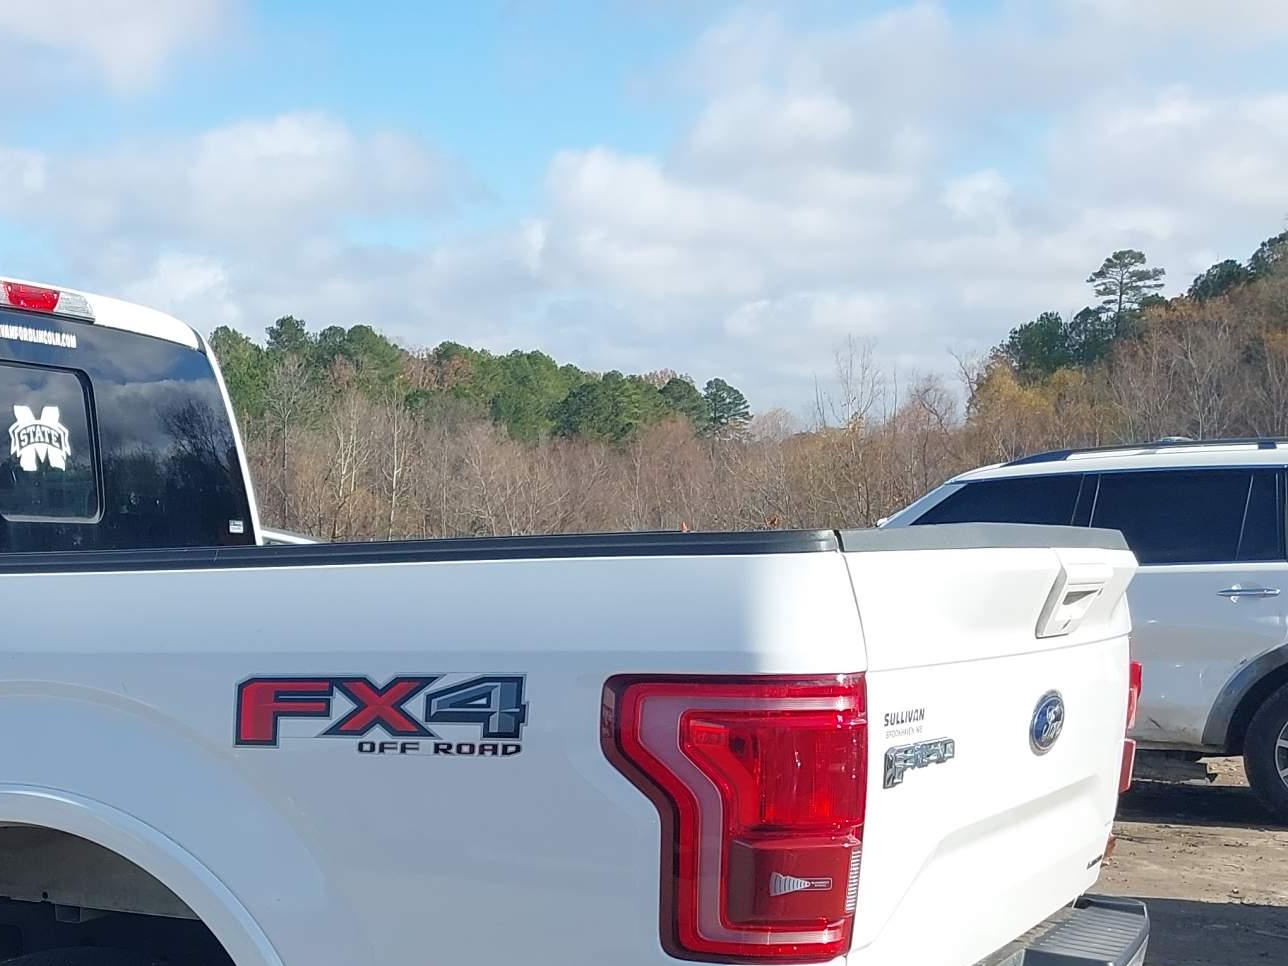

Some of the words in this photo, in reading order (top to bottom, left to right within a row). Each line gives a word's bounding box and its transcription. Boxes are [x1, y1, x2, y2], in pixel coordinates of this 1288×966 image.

[19, 425, 62, 450] STATE
[234, 673, 528, 747] FX4
[883, 708, 926, 727] SULLIVAN
[358, 740, 419, 754] OFF
[434, 741, 522, 756] ROAD
